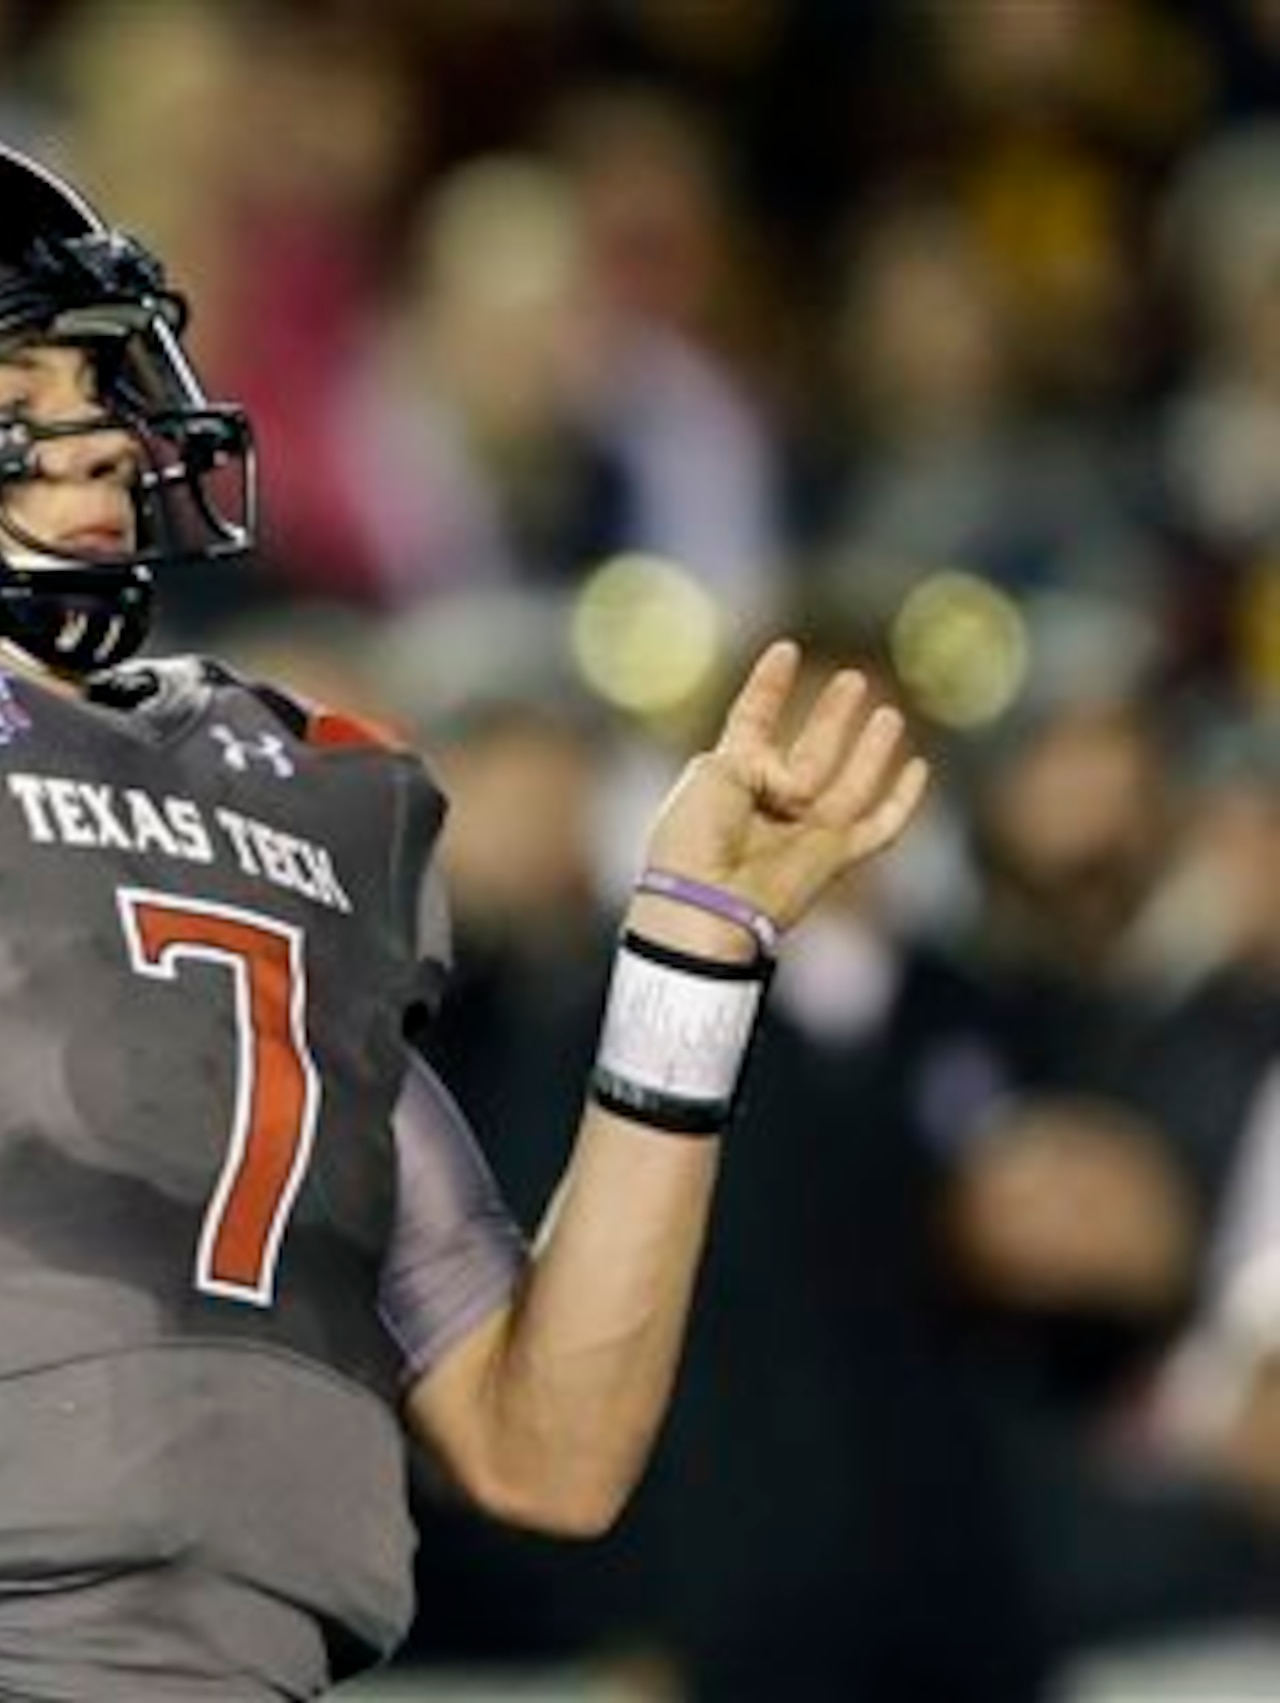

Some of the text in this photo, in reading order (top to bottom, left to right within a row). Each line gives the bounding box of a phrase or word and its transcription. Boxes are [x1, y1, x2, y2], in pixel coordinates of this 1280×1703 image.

[7, 773, 353, 914] TEXAS TECH
[116, 887, 320, 1307] 7
